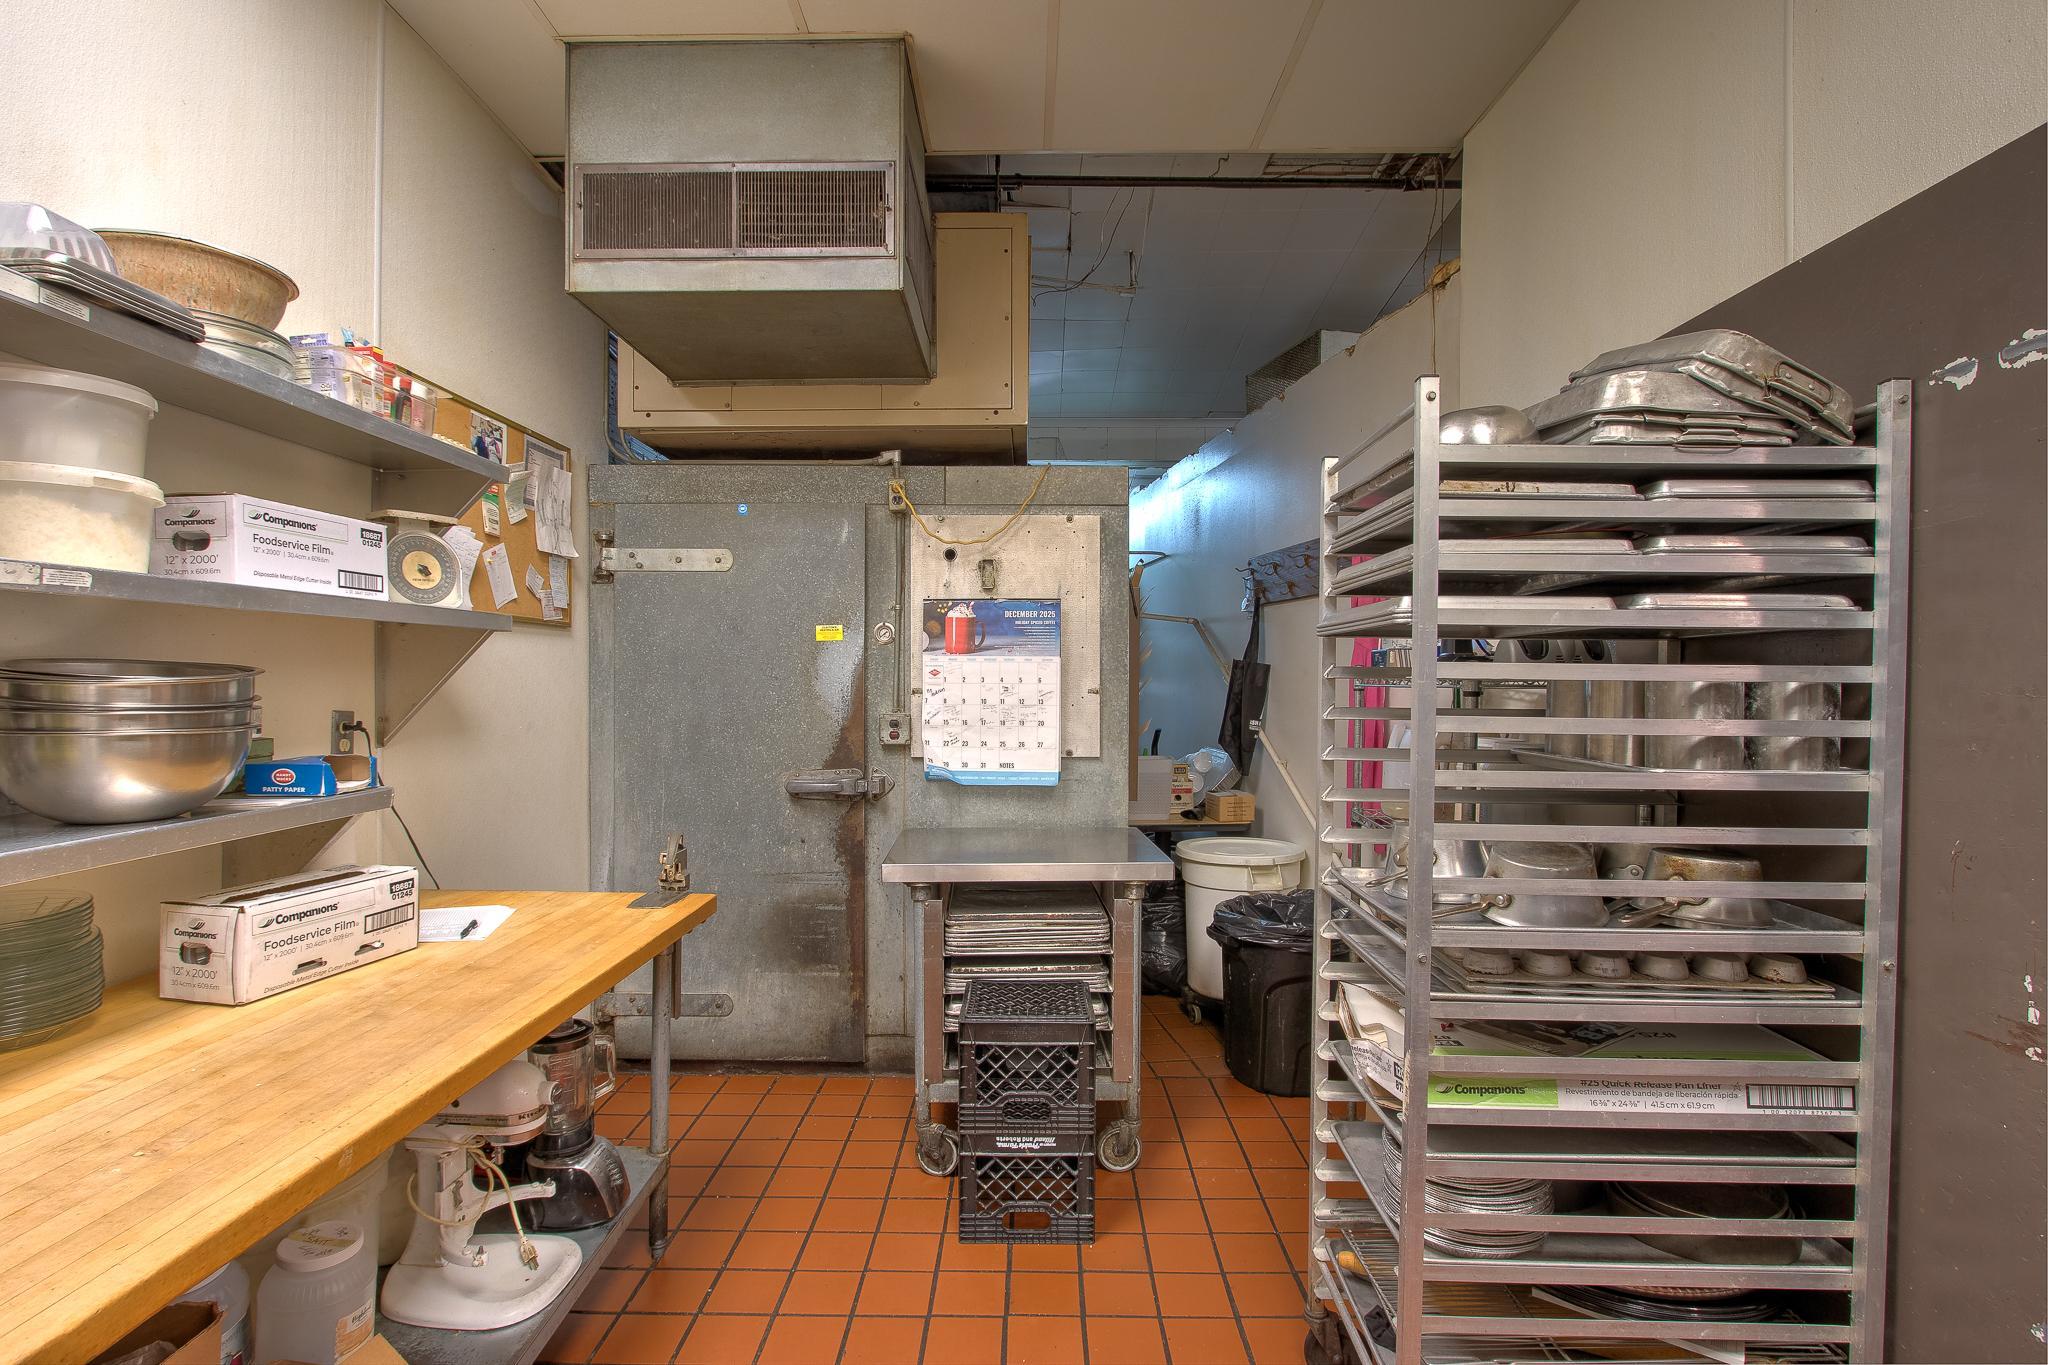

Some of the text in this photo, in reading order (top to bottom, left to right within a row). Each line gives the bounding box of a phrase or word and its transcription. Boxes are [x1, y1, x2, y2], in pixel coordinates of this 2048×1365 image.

[164, 518, 216, 527] Companions
[262, 512, 317, 531] Companions
[253, 533, 331, 555] Foodservice Film
[361, 539, 382, 549] 01245
[165, 555, 179, 565] 12"
[189, 554, 219, 565] 2000'
[164, 568, 189, 576] 30.4cm
[253, 570, 279, 578] Disposable
[294, 575, 305, 583] Edge
[1004, 610, 1056, 618] DECEMBER 2025
[391, 880, 414, 892] 18687
[391, 889, 413, 901] 01245
[275, 902, 339, 925] Companions
[174, 928, 217, 940] Companions
[263, 926, 332, 952] Foodservice
[334, 919, 356, 933] Film
[263, 953, 273, 961] 12"
[172, 966, 184, 976] 12"
[192, 968, 218, 980] 2000'
[263, 979, 295, 994] Disposable
[296, 974, 313, 983] Metal
[313, 969, 328, 979] Edge
[327, 963, 343, 972] Cutter
[1455, 1084, 1526, 1096] Companions
[1580, 1079, 1721, 1090] #25 Quick Release Pan Liner
[1565, 1087, 1619, 1096] Revestimiento
[1621, 1089, 1631, 1097] de
[1632, 1089, 1663, 1099] bandeja
[1675, 1090, 1713, 1099] liberación
[1714, 1092, 1739, 1101] rápida
